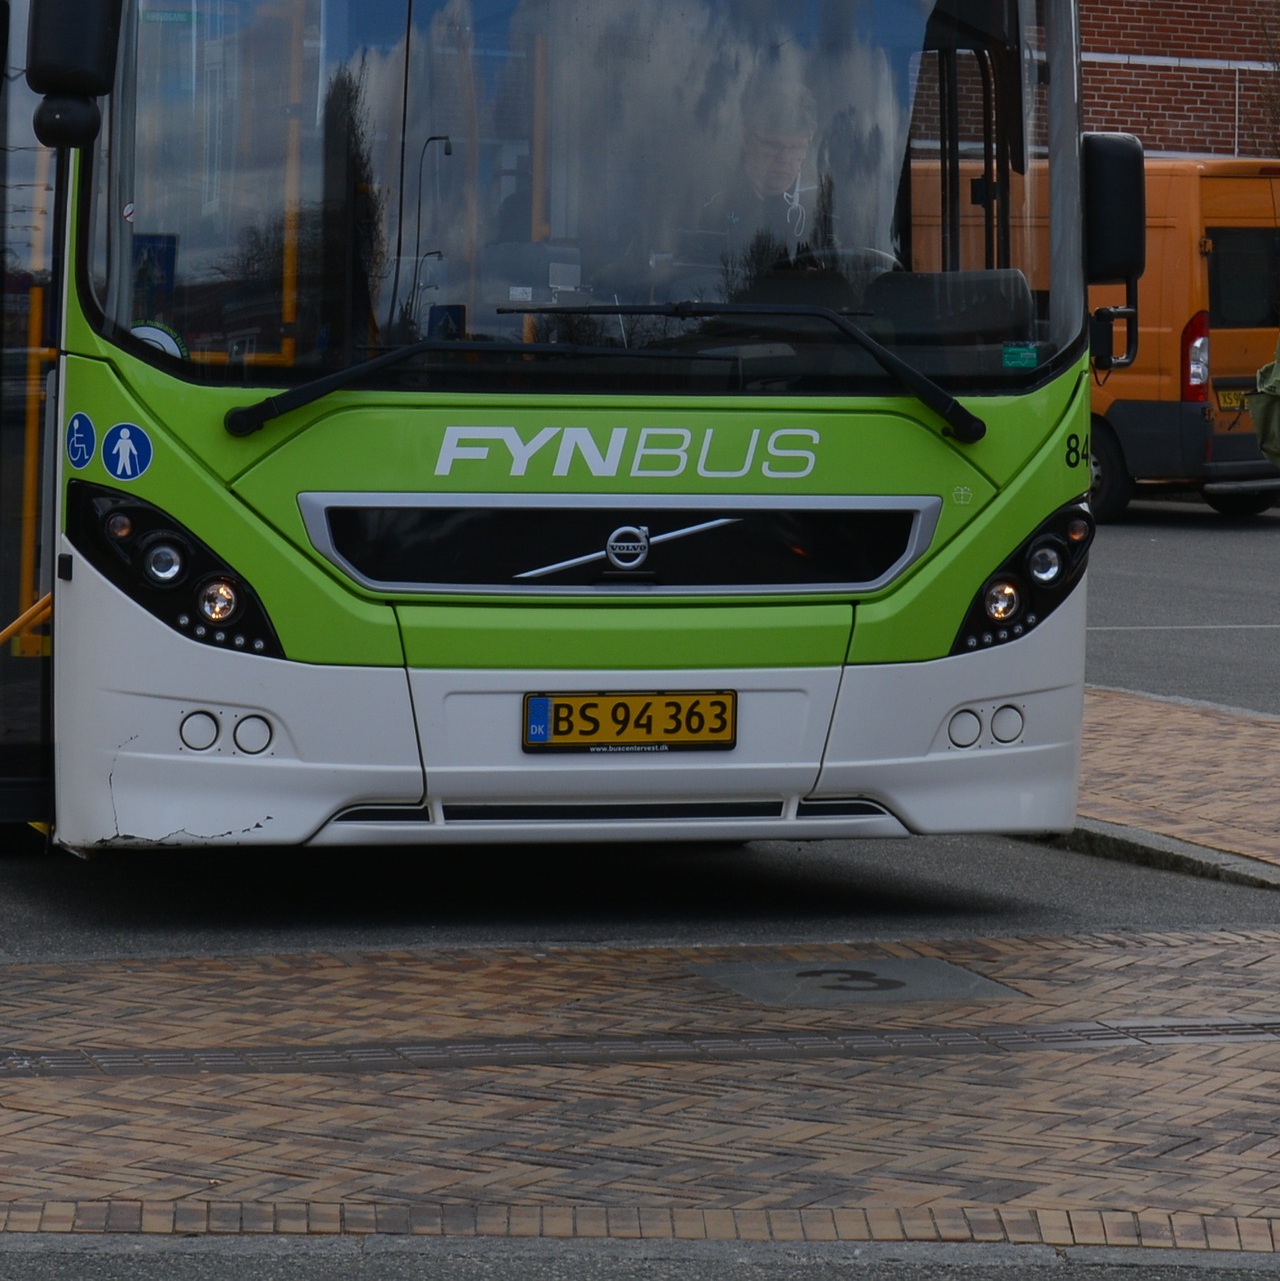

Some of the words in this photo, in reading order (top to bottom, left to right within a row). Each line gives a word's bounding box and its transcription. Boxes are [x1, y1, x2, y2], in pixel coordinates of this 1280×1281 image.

[433, 425, 820, 479] FYNBUS
[1065, 433, 1089, 468] 84
[609, 544, 646, 552] VOLVO
[530, 724, 545, 735] DK
[552, 701, 601, 737] BS
[610, 700, 653, 737] 94
[663, 699, 728, 735] 363
[589, 743, 669, 752] www.buscentervest.dk
